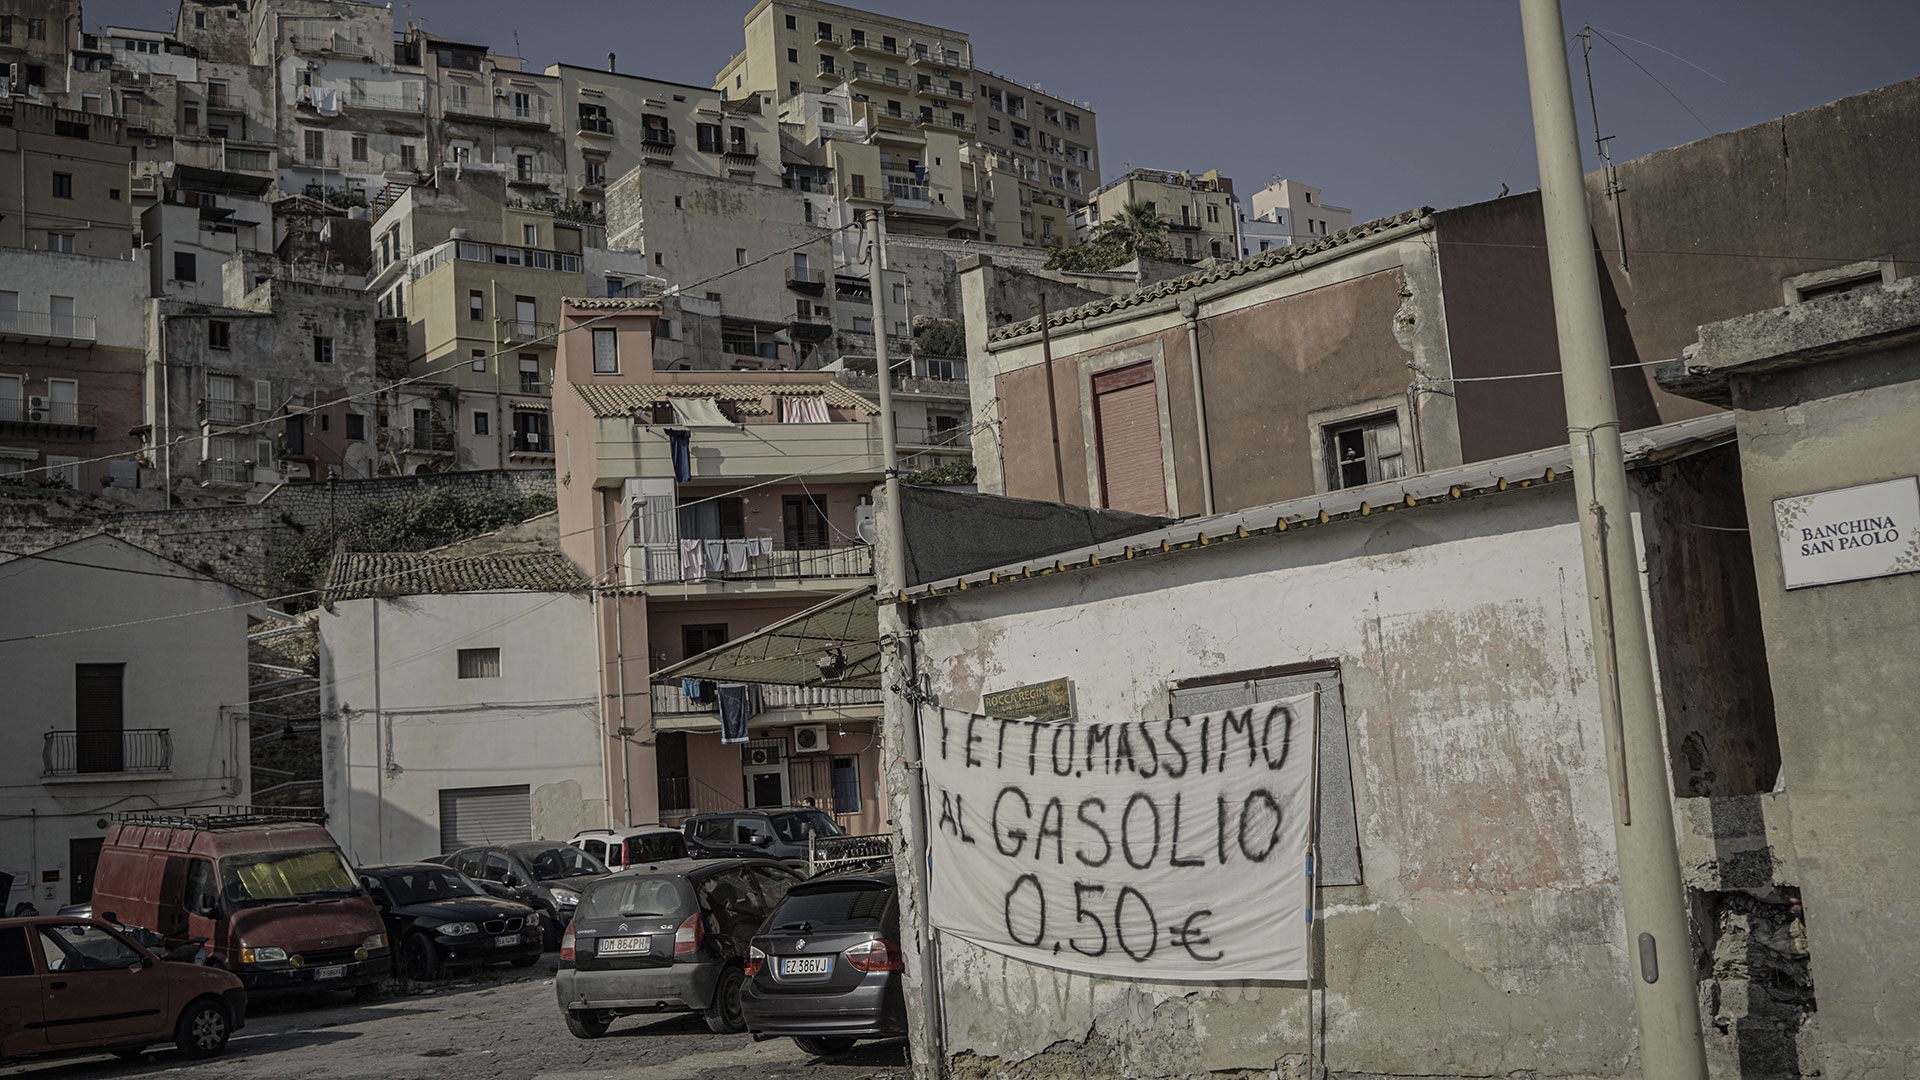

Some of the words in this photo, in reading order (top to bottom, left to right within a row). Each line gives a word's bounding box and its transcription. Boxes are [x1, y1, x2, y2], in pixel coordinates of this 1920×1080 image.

[1801, 515, 1896, 541] BANCHINA
[1801, 539, 1834, 557] SAN
[1839, 529, 1899, 551] PAOLO
[986, 694, 1016, 706] ROCCA
[1020, 687, 1051, 701] REGINA
[939, 789, 975, 844] AL
[992, 786, 1283, 869] GASOLIO
[604, 939, 614, 950] DM
[617, 938, 645, 950] 864PH
[786, 960, 796, 973] EZ
[799, 959, 826, 972] 386VJ
